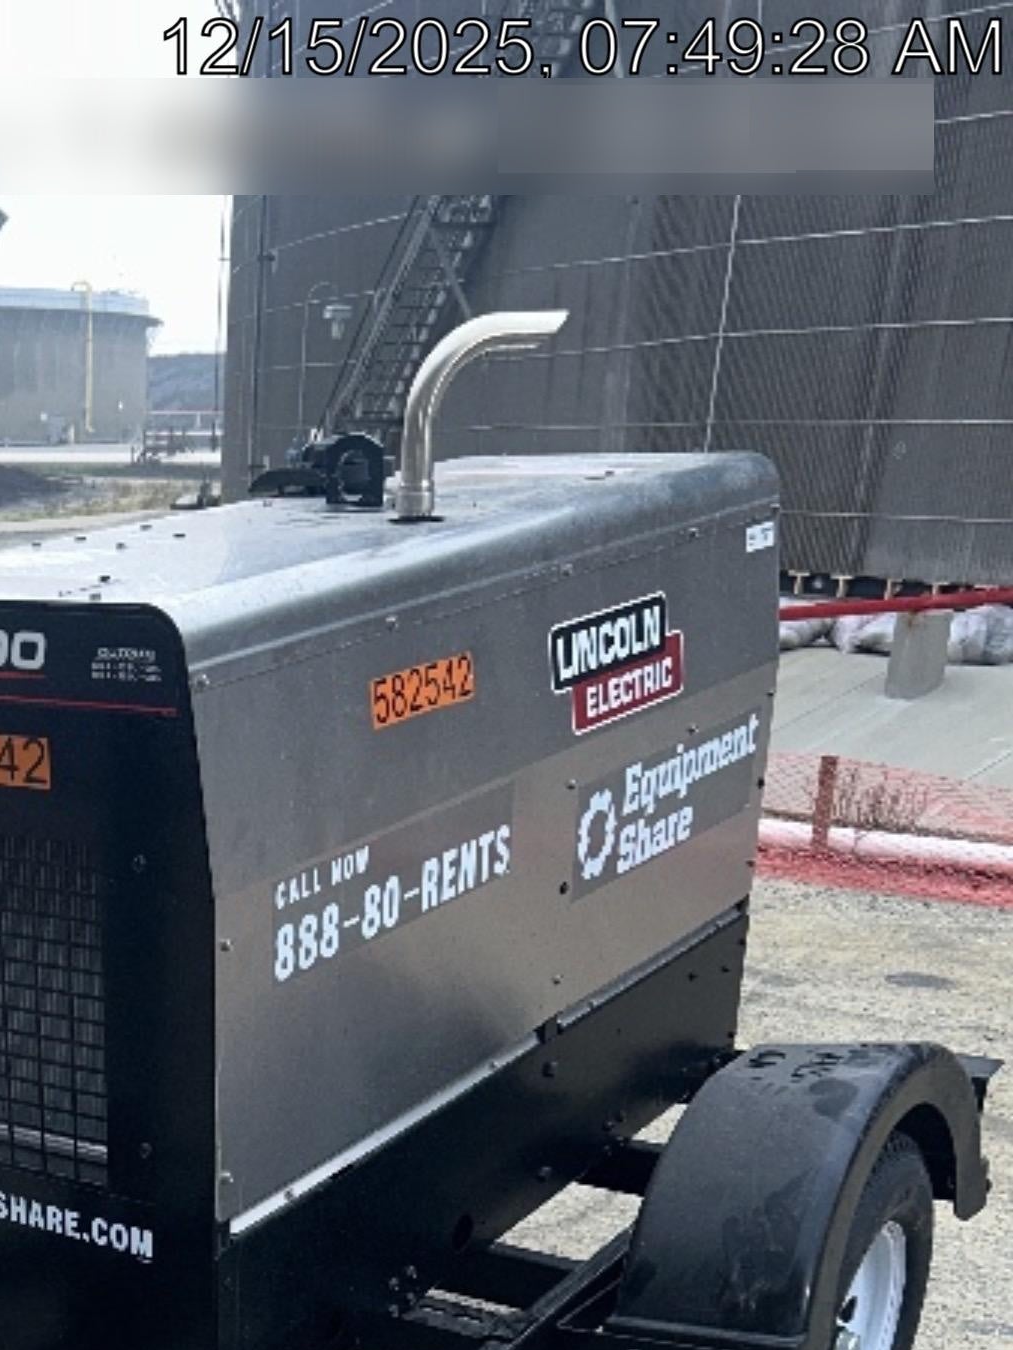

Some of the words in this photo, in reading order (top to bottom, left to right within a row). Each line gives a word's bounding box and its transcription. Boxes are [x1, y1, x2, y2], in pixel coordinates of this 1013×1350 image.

[556, 605, 661, 678] LINCOLN
[374, 653, 473, 724] 582542
[586, 656, 673, 718] ELECTRIC
[622, 713, 760, 818] Equipment
[616, 804, 694, 874] Share
[273, 824, 512, 983] 888-80-RENTS
[275, 875, 321, 910] CALL
[331, 846, 370, 887] NOW
